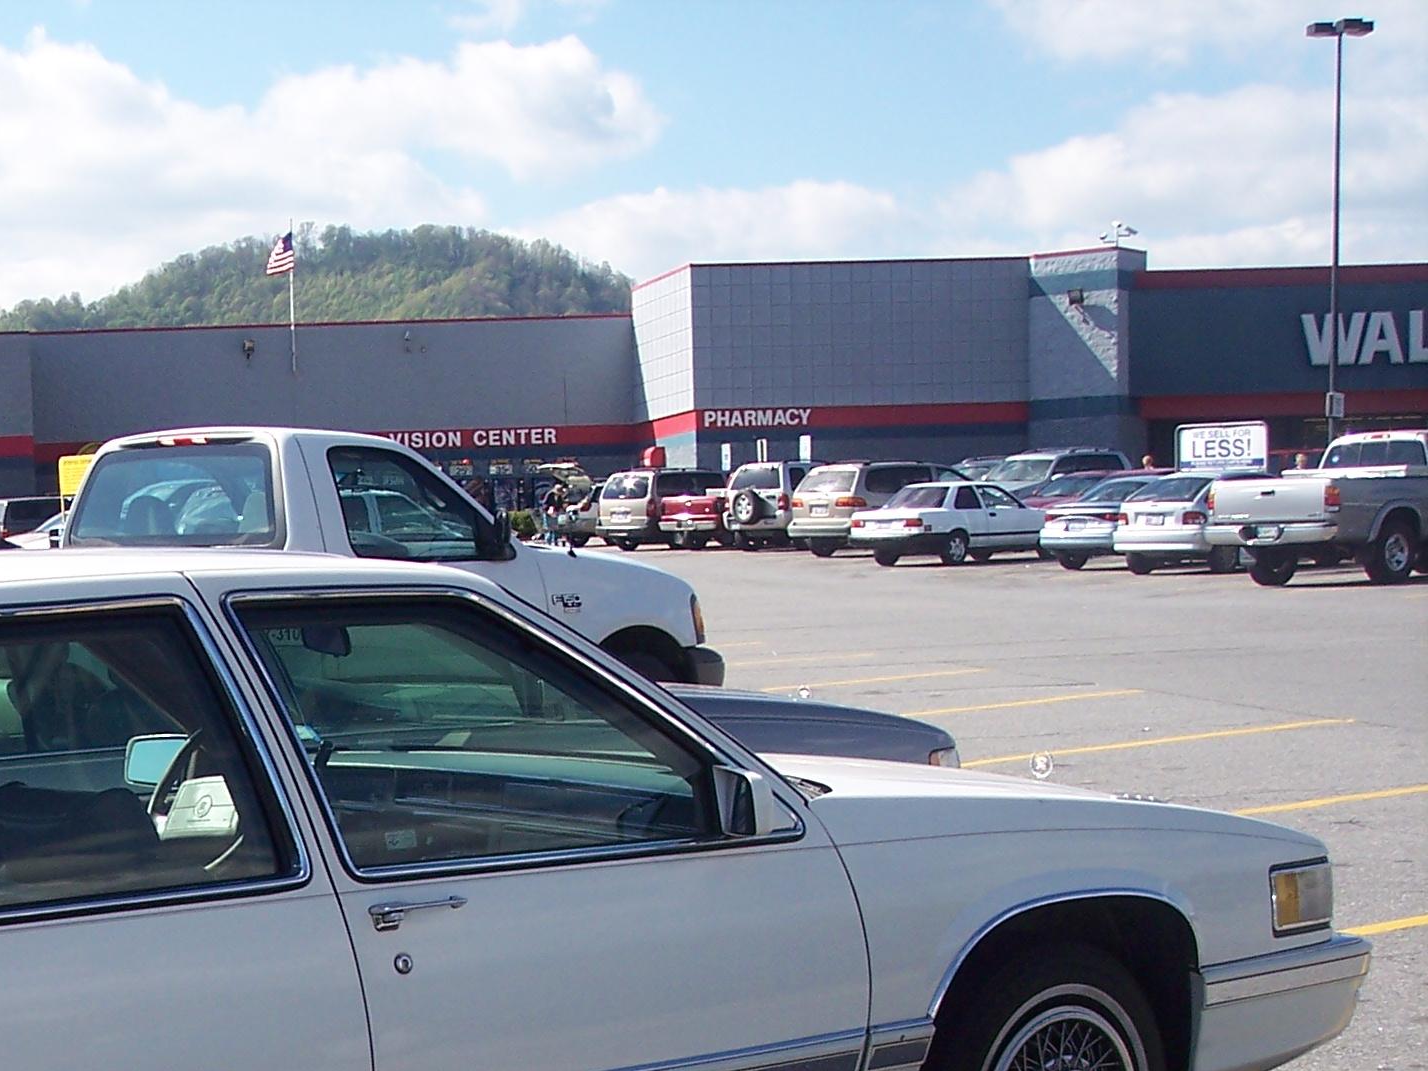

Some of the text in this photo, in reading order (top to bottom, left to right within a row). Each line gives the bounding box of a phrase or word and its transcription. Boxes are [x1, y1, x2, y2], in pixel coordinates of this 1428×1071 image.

[703, 408, 812, 428] PHARMACY
[388, 428, 557, 449] VISION CENTER
[1208, 430, 1231, 439] SELL
[1233, 428, 1251, 437] FOR
[1192, 438, 1252, 459] LESS!
